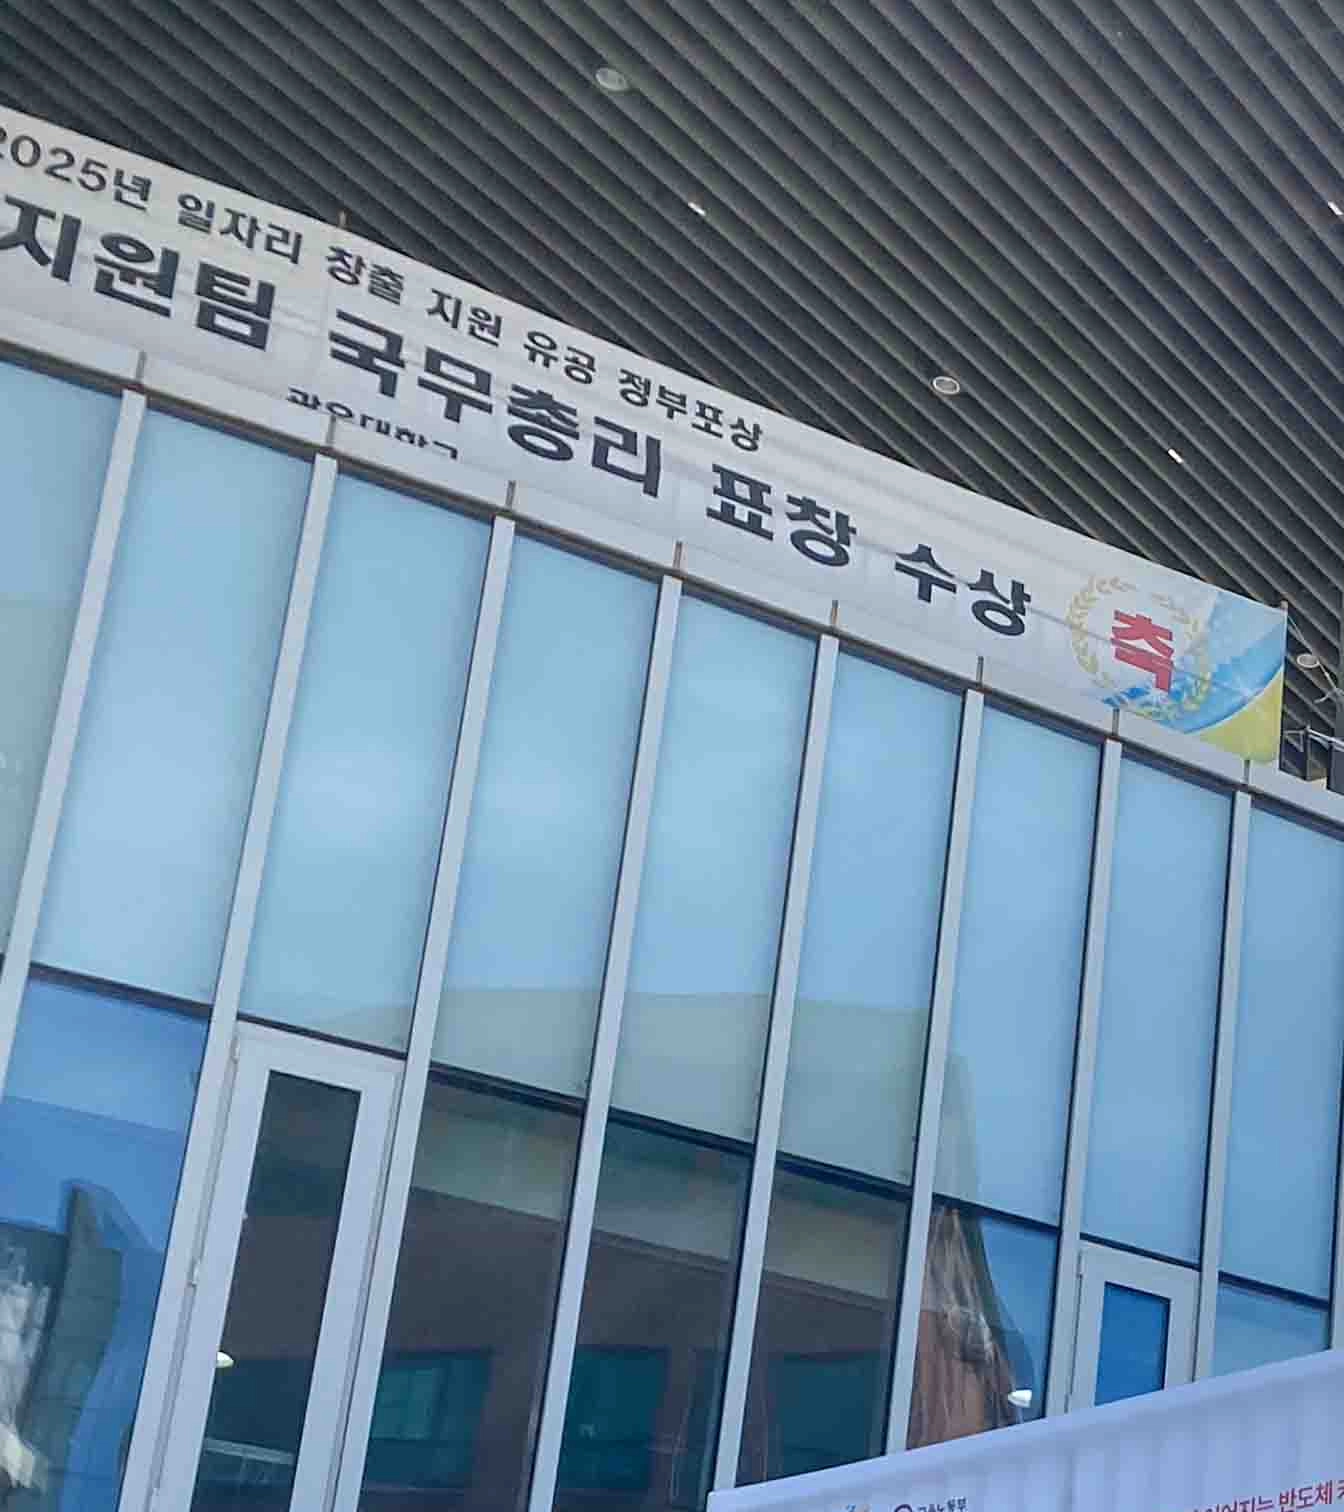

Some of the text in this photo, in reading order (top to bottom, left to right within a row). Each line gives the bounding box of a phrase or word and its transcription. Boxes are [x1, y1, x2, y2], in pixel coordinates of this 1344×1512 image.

[0, 126, 763, 452] 025년 일자리 창출 지원 유공 정부포상
[0, 194, 1031, 636] 지원팀 국무총리 표창 수상
[1110, 608, 1173, 692] 축
